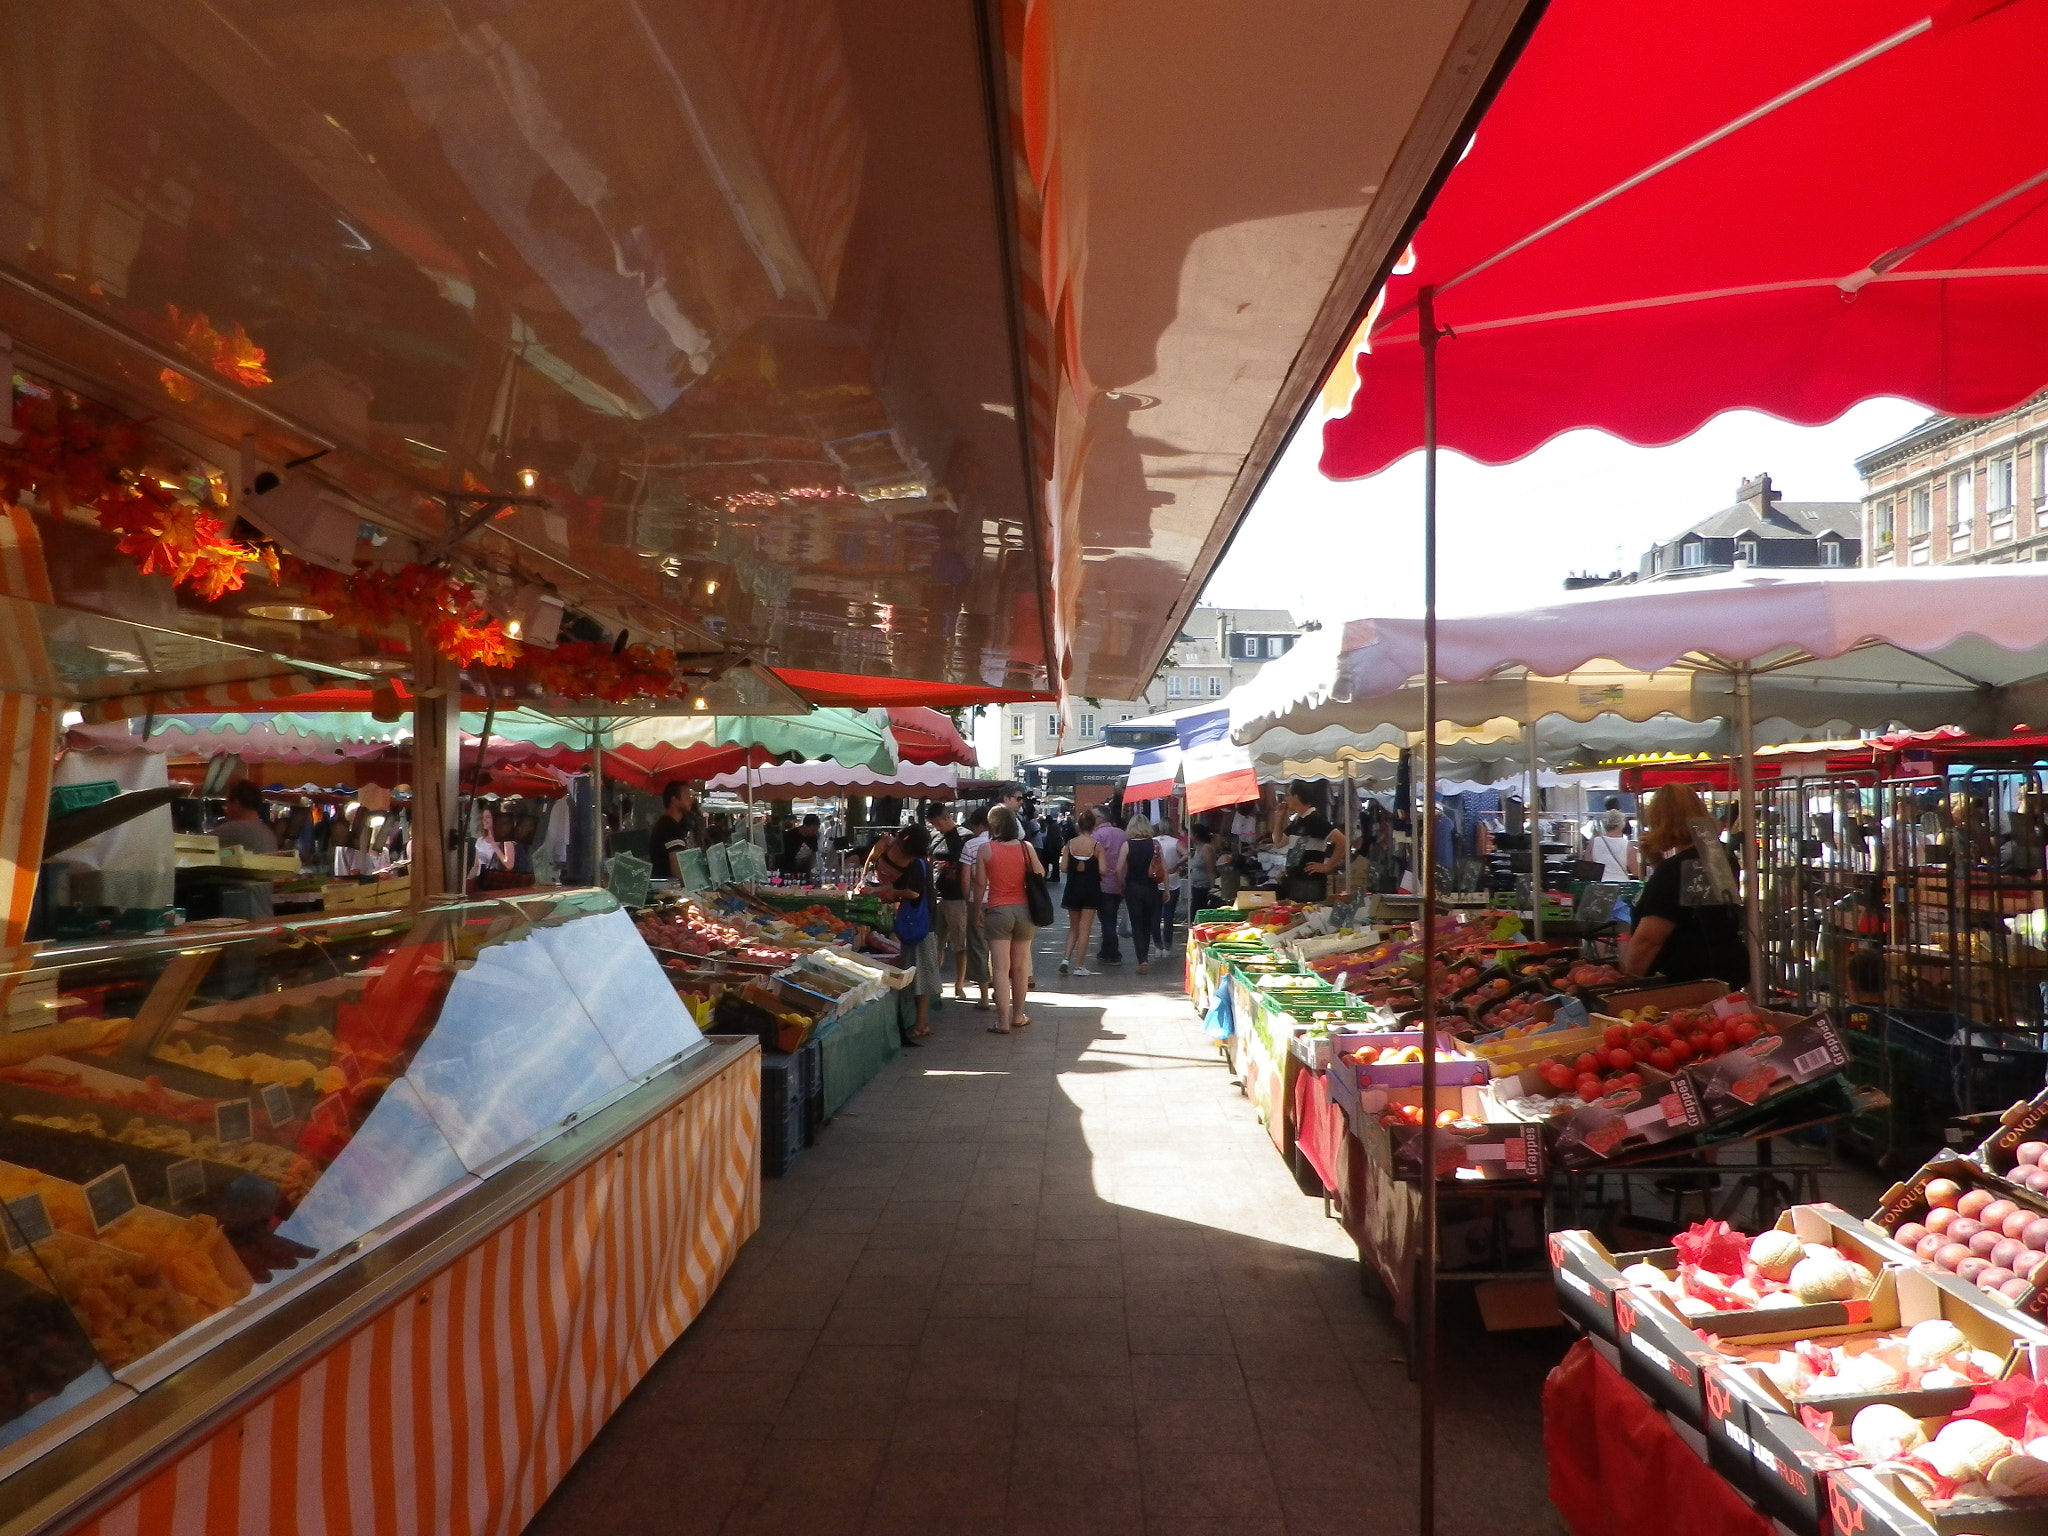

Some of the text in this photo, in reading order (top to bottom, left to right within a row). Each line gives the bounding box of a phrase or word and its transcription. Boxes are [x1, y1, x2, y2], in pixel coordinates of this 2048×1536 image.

[1816, 1019, 1845, 1066] Grappes
[1676, 1079, 1699, 1127] Grappes
[1999, 1101, 2048, 1148] CONQUE
[1526, 1127, 1538, 1175] Grappes
[1877, 1179, 1927, 1229] CONQUET
